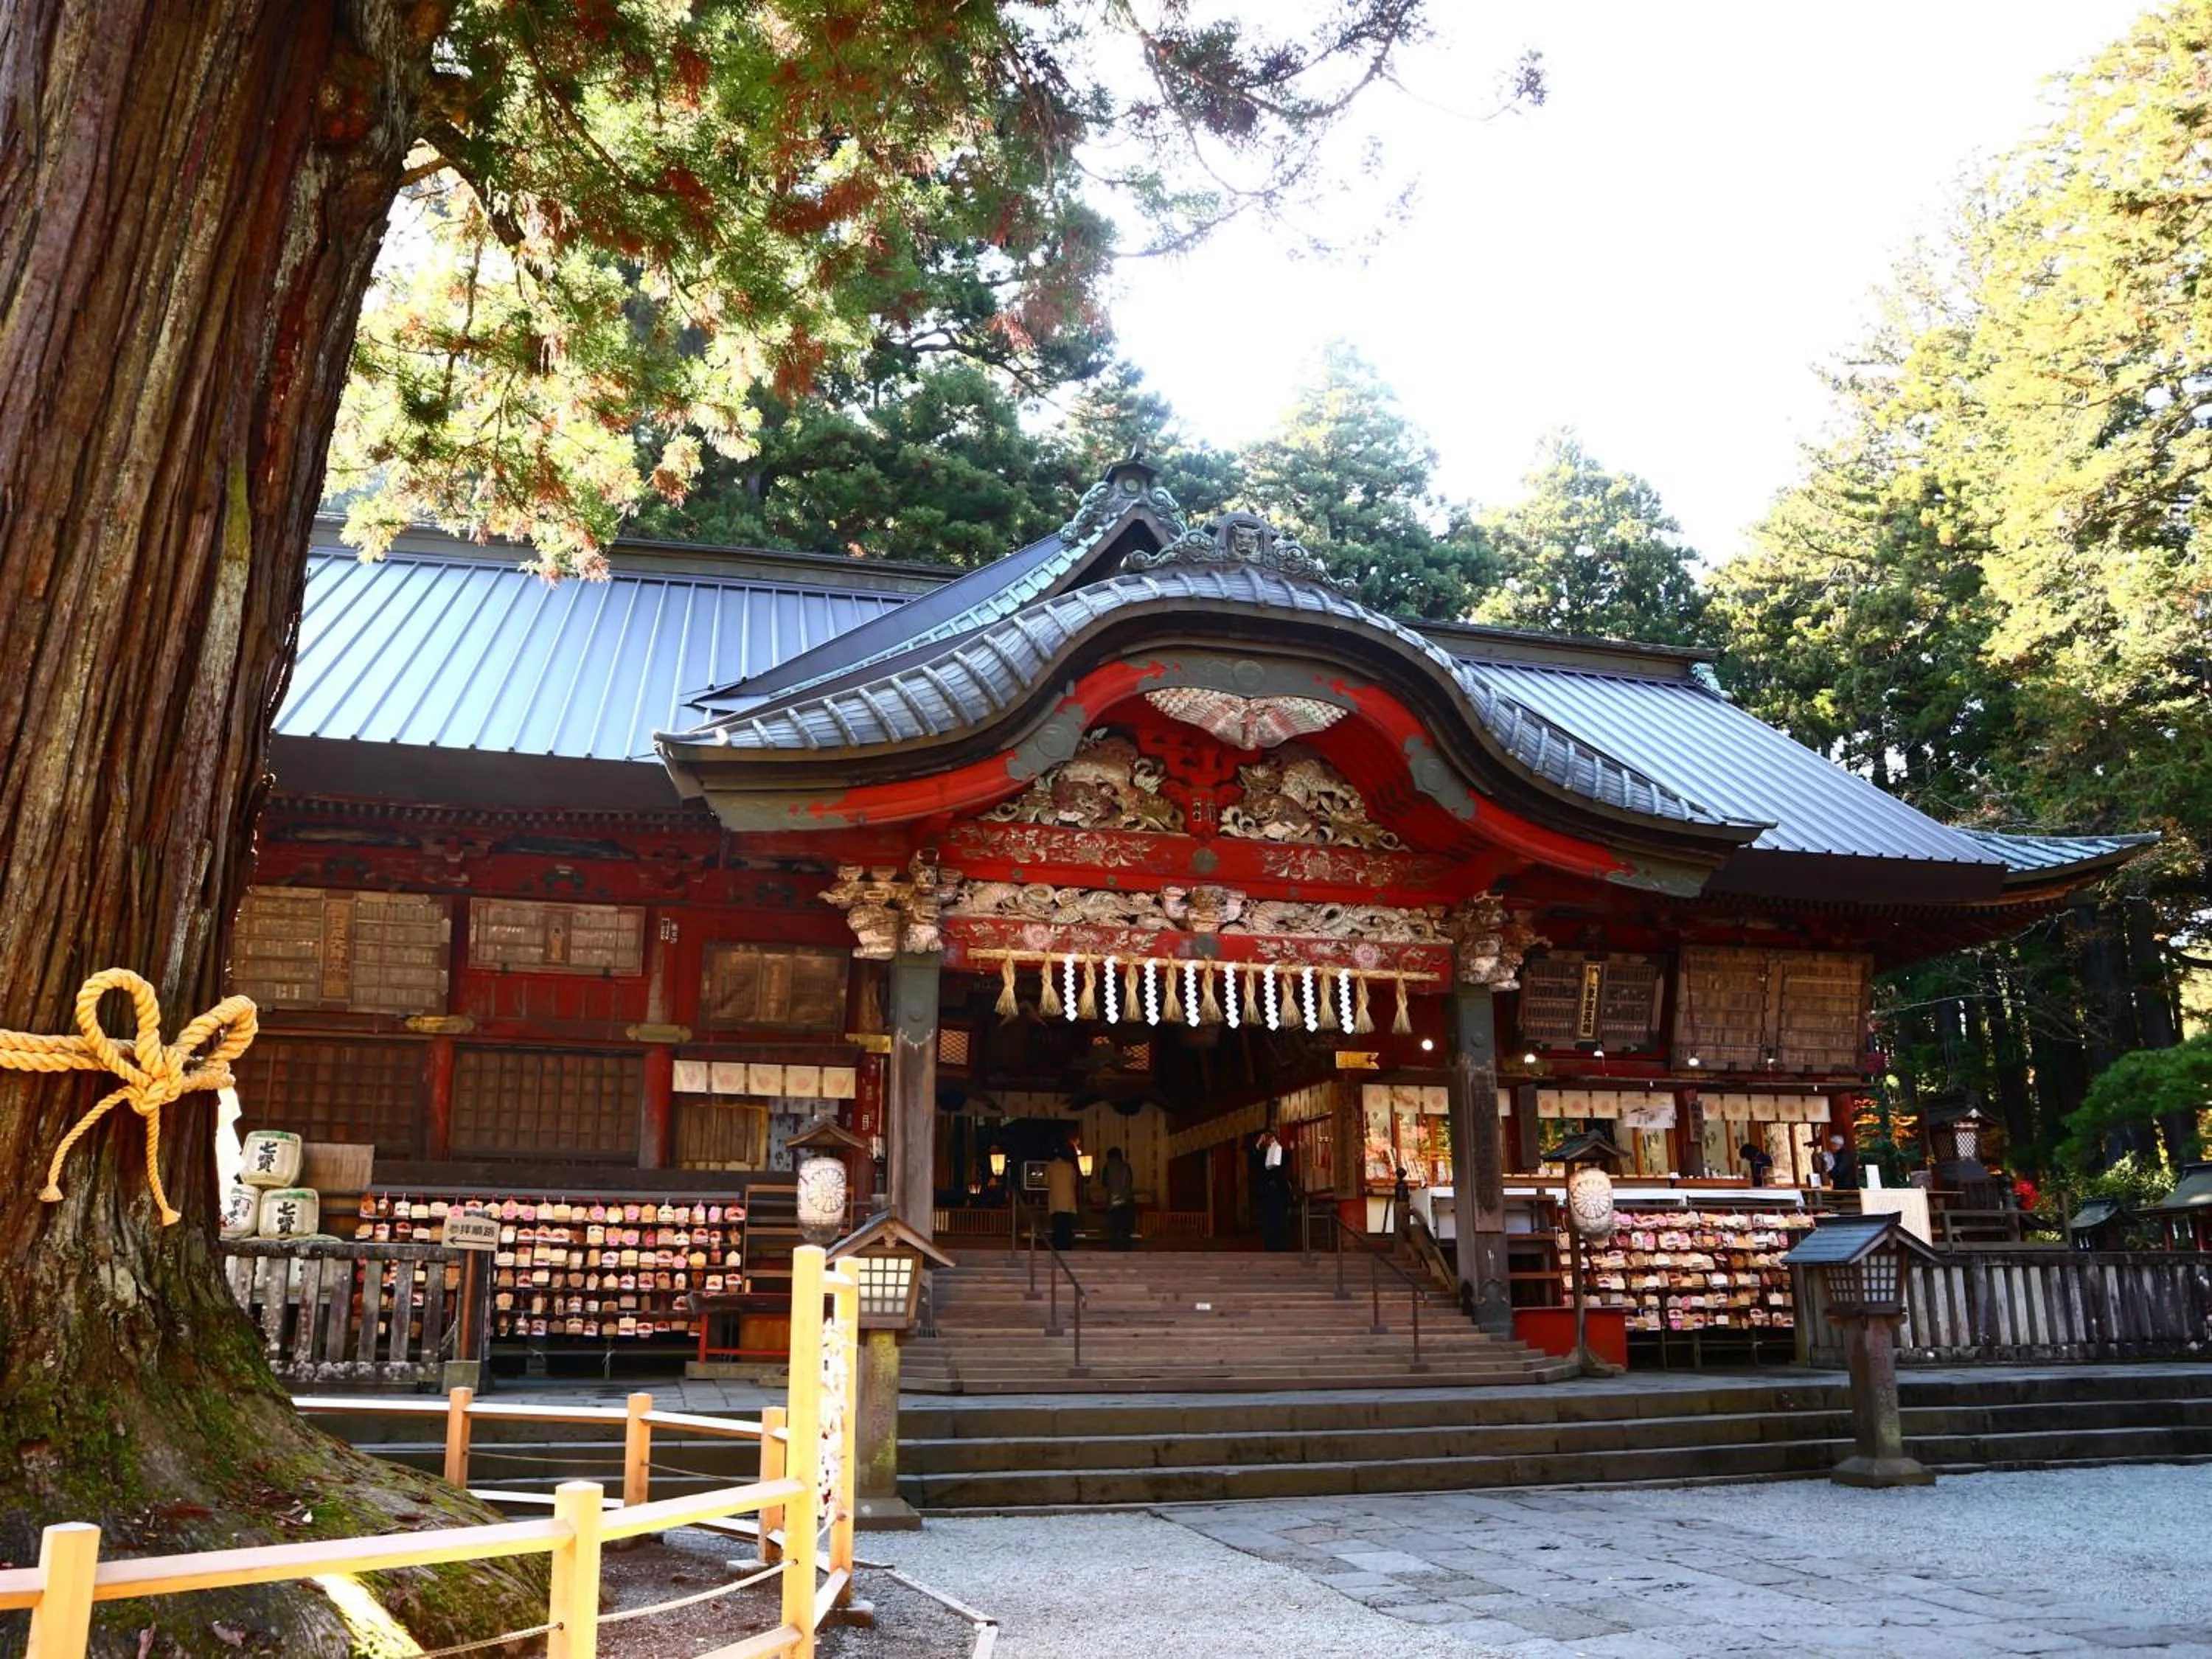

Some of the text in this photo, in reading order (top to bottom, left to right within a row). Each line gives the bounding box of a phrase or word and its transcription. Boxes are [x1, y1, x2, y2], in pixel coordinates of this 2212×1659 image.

[257, 1141, 277, 1173] 七賢
[276, 1201, 296, 1234] 七賢
[448, 1223, 495, 1237] 参拝順路
